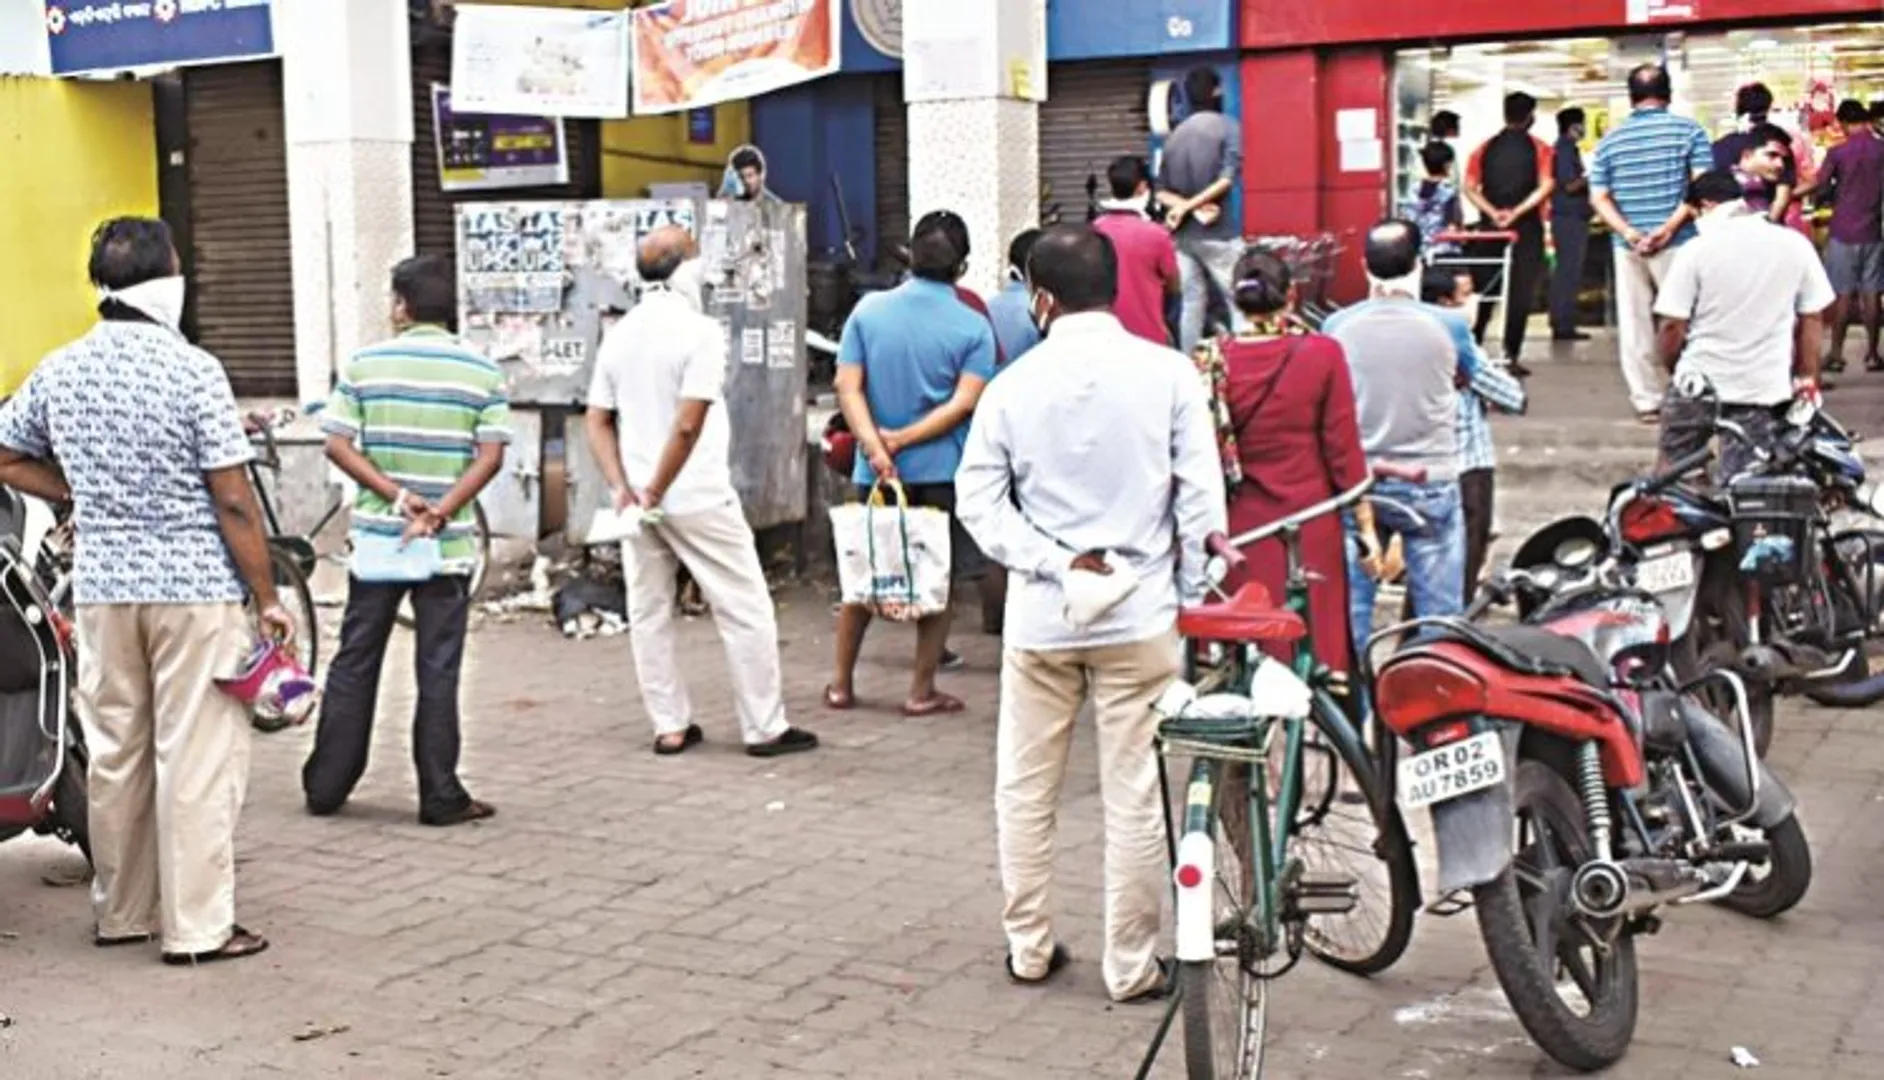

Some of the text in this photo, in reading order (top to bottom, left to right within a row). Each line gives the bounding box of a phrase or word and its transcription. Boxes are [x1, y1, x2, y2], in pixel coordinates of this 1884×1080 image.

[466, 212, 517, 232] IAS
[639, 210, 692, 230] IAS
[1415, 741, 1485, 777] OR 02
